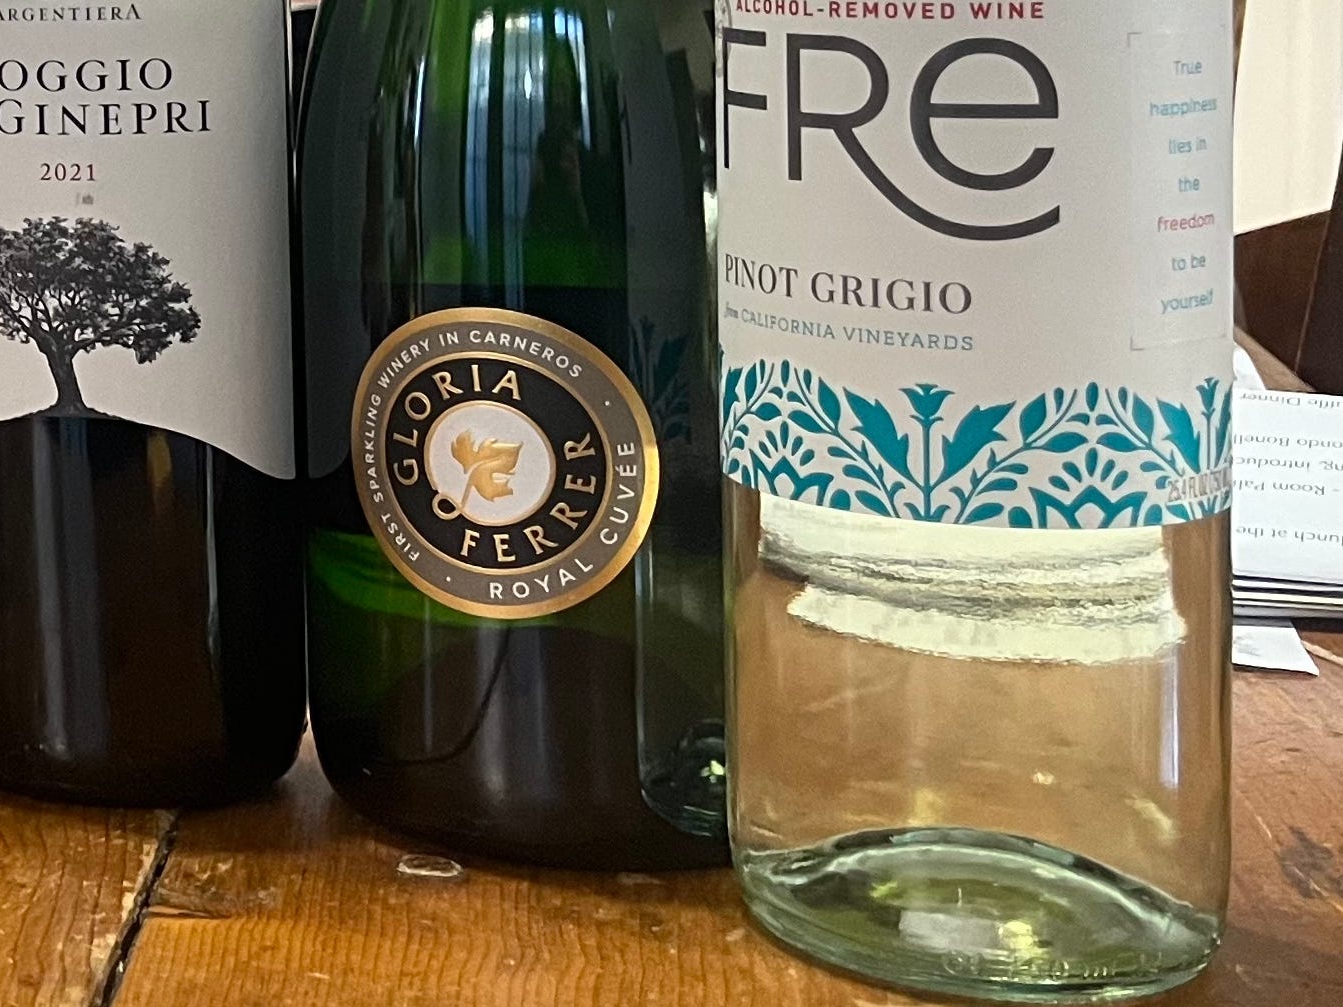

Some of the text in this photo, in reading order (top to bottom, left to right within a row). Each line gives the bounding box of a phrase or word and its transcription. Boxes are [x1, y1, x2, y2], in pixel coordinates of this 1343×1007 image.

[969, 1, 1045, 19] WINE
[1173, 59, 1203, 75] True
[1149, 97, 1218, 117] happiness
[1168, 136, 1207, 155] lies in
[40, 163, 97, 182] 2021
[1178, 175, 1200, 193] the
[1157, 212, 1215, 233] freedom
[1171, 253, 1207, 272] to be
[724, 252, 973, 315] PINOT GRIGIO
[1161, 287, 1214, 315] yourself
[740, 307, 836, 340] CALIFORNIA
[842, 325, 974, 351] VINEYARDS
[1240, 392, 1301, 407] Dinner
[393, 364, 522, 487] GLORIA
[364, 329, 583, 562] FIRST SPARKLING WINERY IN CARNEROS
[460, 433, 597, 563] FERRER
[1272, 481, 1325, 496] Room
[489, 441, 638, 600] ROYAL CUVÉE
[1236, 525, 1264, 538] the
[1271, 528, 1287, 538] at
